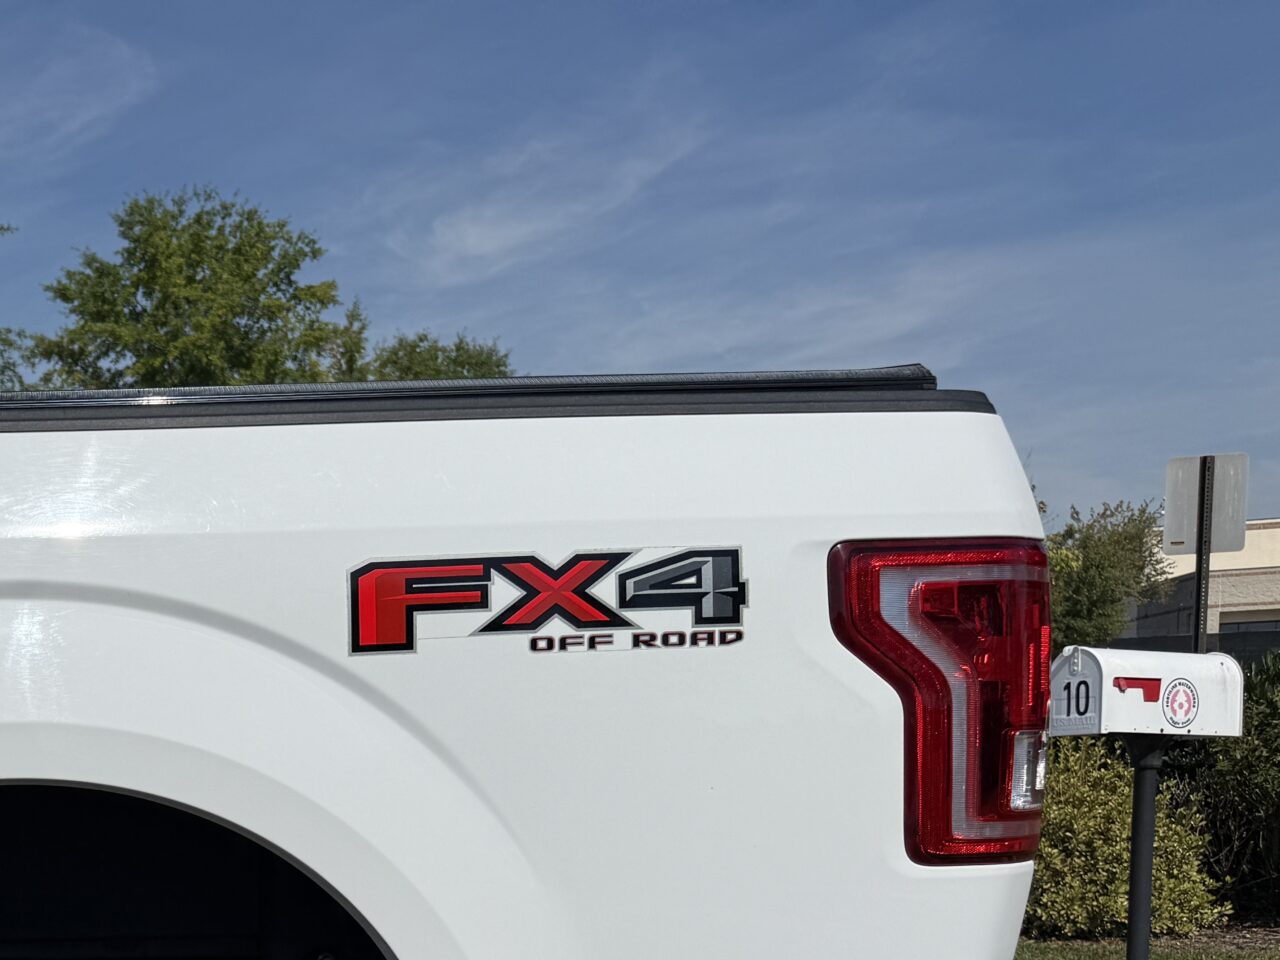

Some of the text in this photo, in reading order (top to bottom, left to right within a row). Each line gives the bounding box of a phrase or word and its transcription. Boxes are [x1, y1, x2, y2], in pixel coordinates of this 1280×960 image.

[346, 545, 750, 656] FX4
[529, 629, 745, 652] OFF ROAD
[1063, 680, 1090, 717] 10
